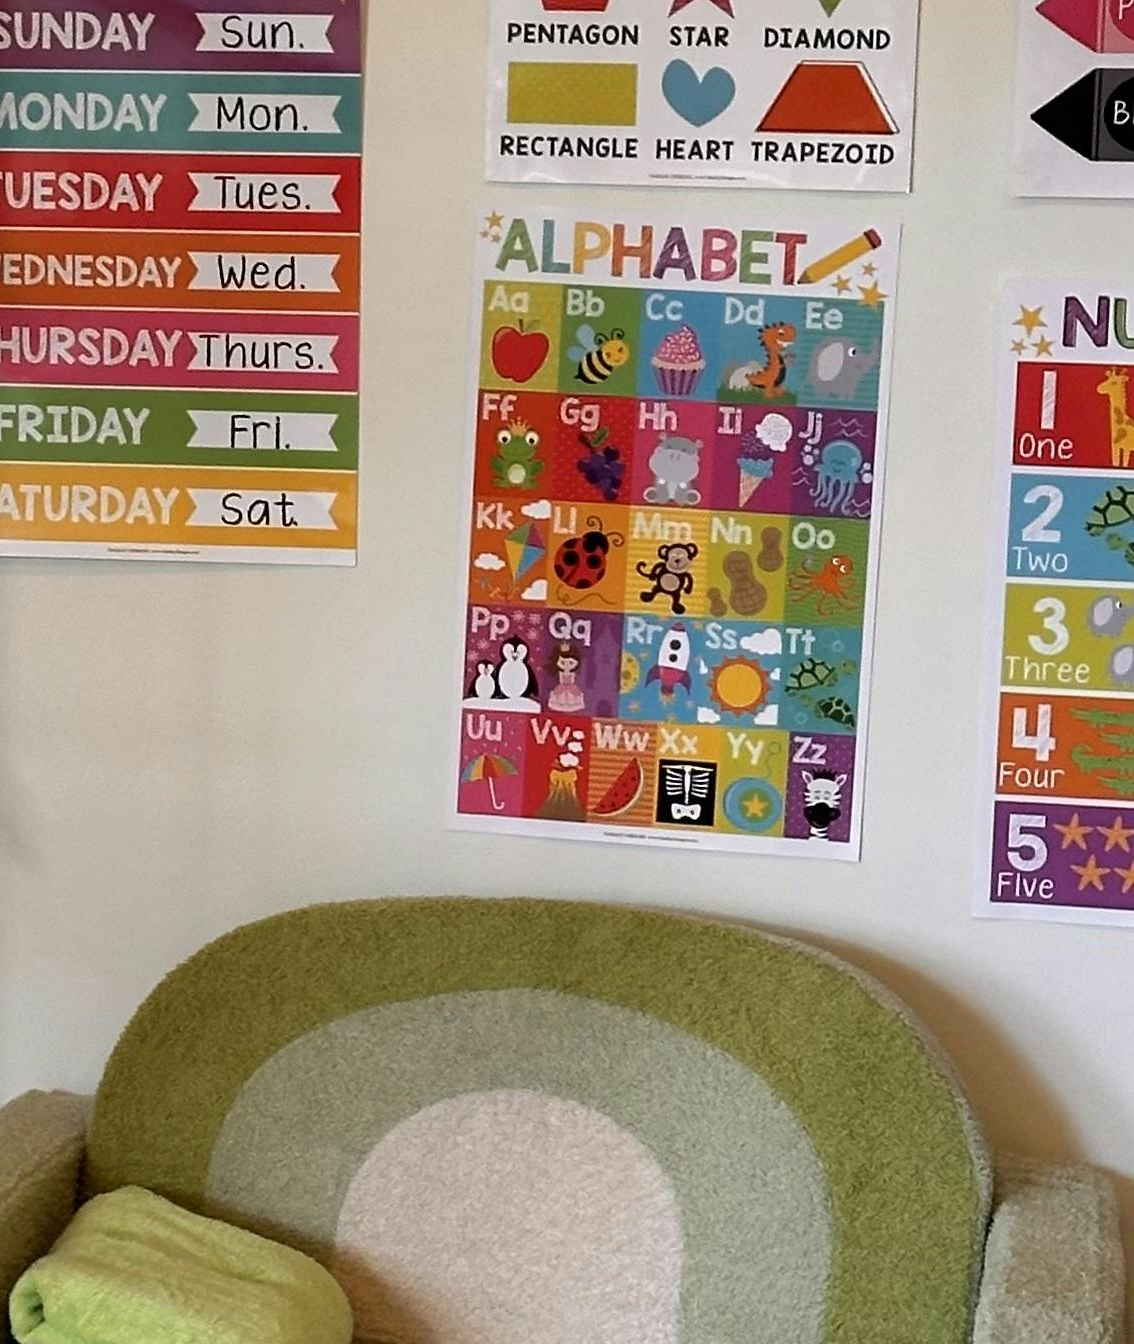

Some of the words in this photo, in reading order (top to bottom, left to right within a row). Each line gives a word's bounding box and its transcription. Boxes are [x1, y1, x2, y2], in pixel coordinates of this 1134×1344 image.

[221, 15, 304, 49] Sun.
[507, 23, 639, 45] PENTAGON
[670, 26, 729, 47] STAR
[764, 28, 891, 50] DIAMOND
[216, 96, 308, 131] Mon.
[500, 136, 638, 158] RECTANGLE
[655, 140, 734, 161] HEART
[751, 142, 895, 164] TRAPEZOID
[214, 176, 311, 210] Tues.
[496, 218, 807, 285] ALPHABET
[218, 255, 306, 290] Wed.
[488, 286, 529, 313] Aa
[566, 289, 604, 316] Bb
[645, 295, 683, 321] Cc
[724, 298, 764, 325] Dd
[805, 302, 843, 329] Ee
[200, 335, 324, 370] Thurs.
[1041, 370, 1057, 430] 1
[231, 414, 291, 450] Fri.
[482, 394, 516, 421] Ff
[560, 398, 601, 432] Gg
[639, 404, 677, 431] Hh
[718, 407, 742, 434] Ii
[798, 411, 822, 444] Jj
[1019, 432, 1074, 459] One
[221, 493, 298, 526] Sat.
[475, 504, 513, 530] Kk
[553, 507, 576, 534] Ll
[632, 514, 693, 540] Mm
[711, 518, 752, 545] Nn
[792, 523, 836, 550] Oo
[1022, 485, 1063, 542] 2
[1012, 547, 1068, 573] Two
[471, 607, 510, 640] Pp
[548, 613, 592, 646] Qq
[626, 617, 663, 644] Rr
[705, 624, 737, 650] Ss
[786, 628, 816, 655] Tt
[1028, 597, 1069, 655] 3
[1005, 656, 1090, 684] Three
[466, 714, 502, 742] Uu
[530, 718, 566, 746] Vv
[594, 724, 649, 751] Ww
[659, 729, 697, 755] Xx
[726, 732, 764, 765] Yy
[792, 737, 826, 765] Zz
[1013, 705, 1056, 762] 4
[998, 762, 1065, 788] Four
[1007, 814, 1048, 872] 5
